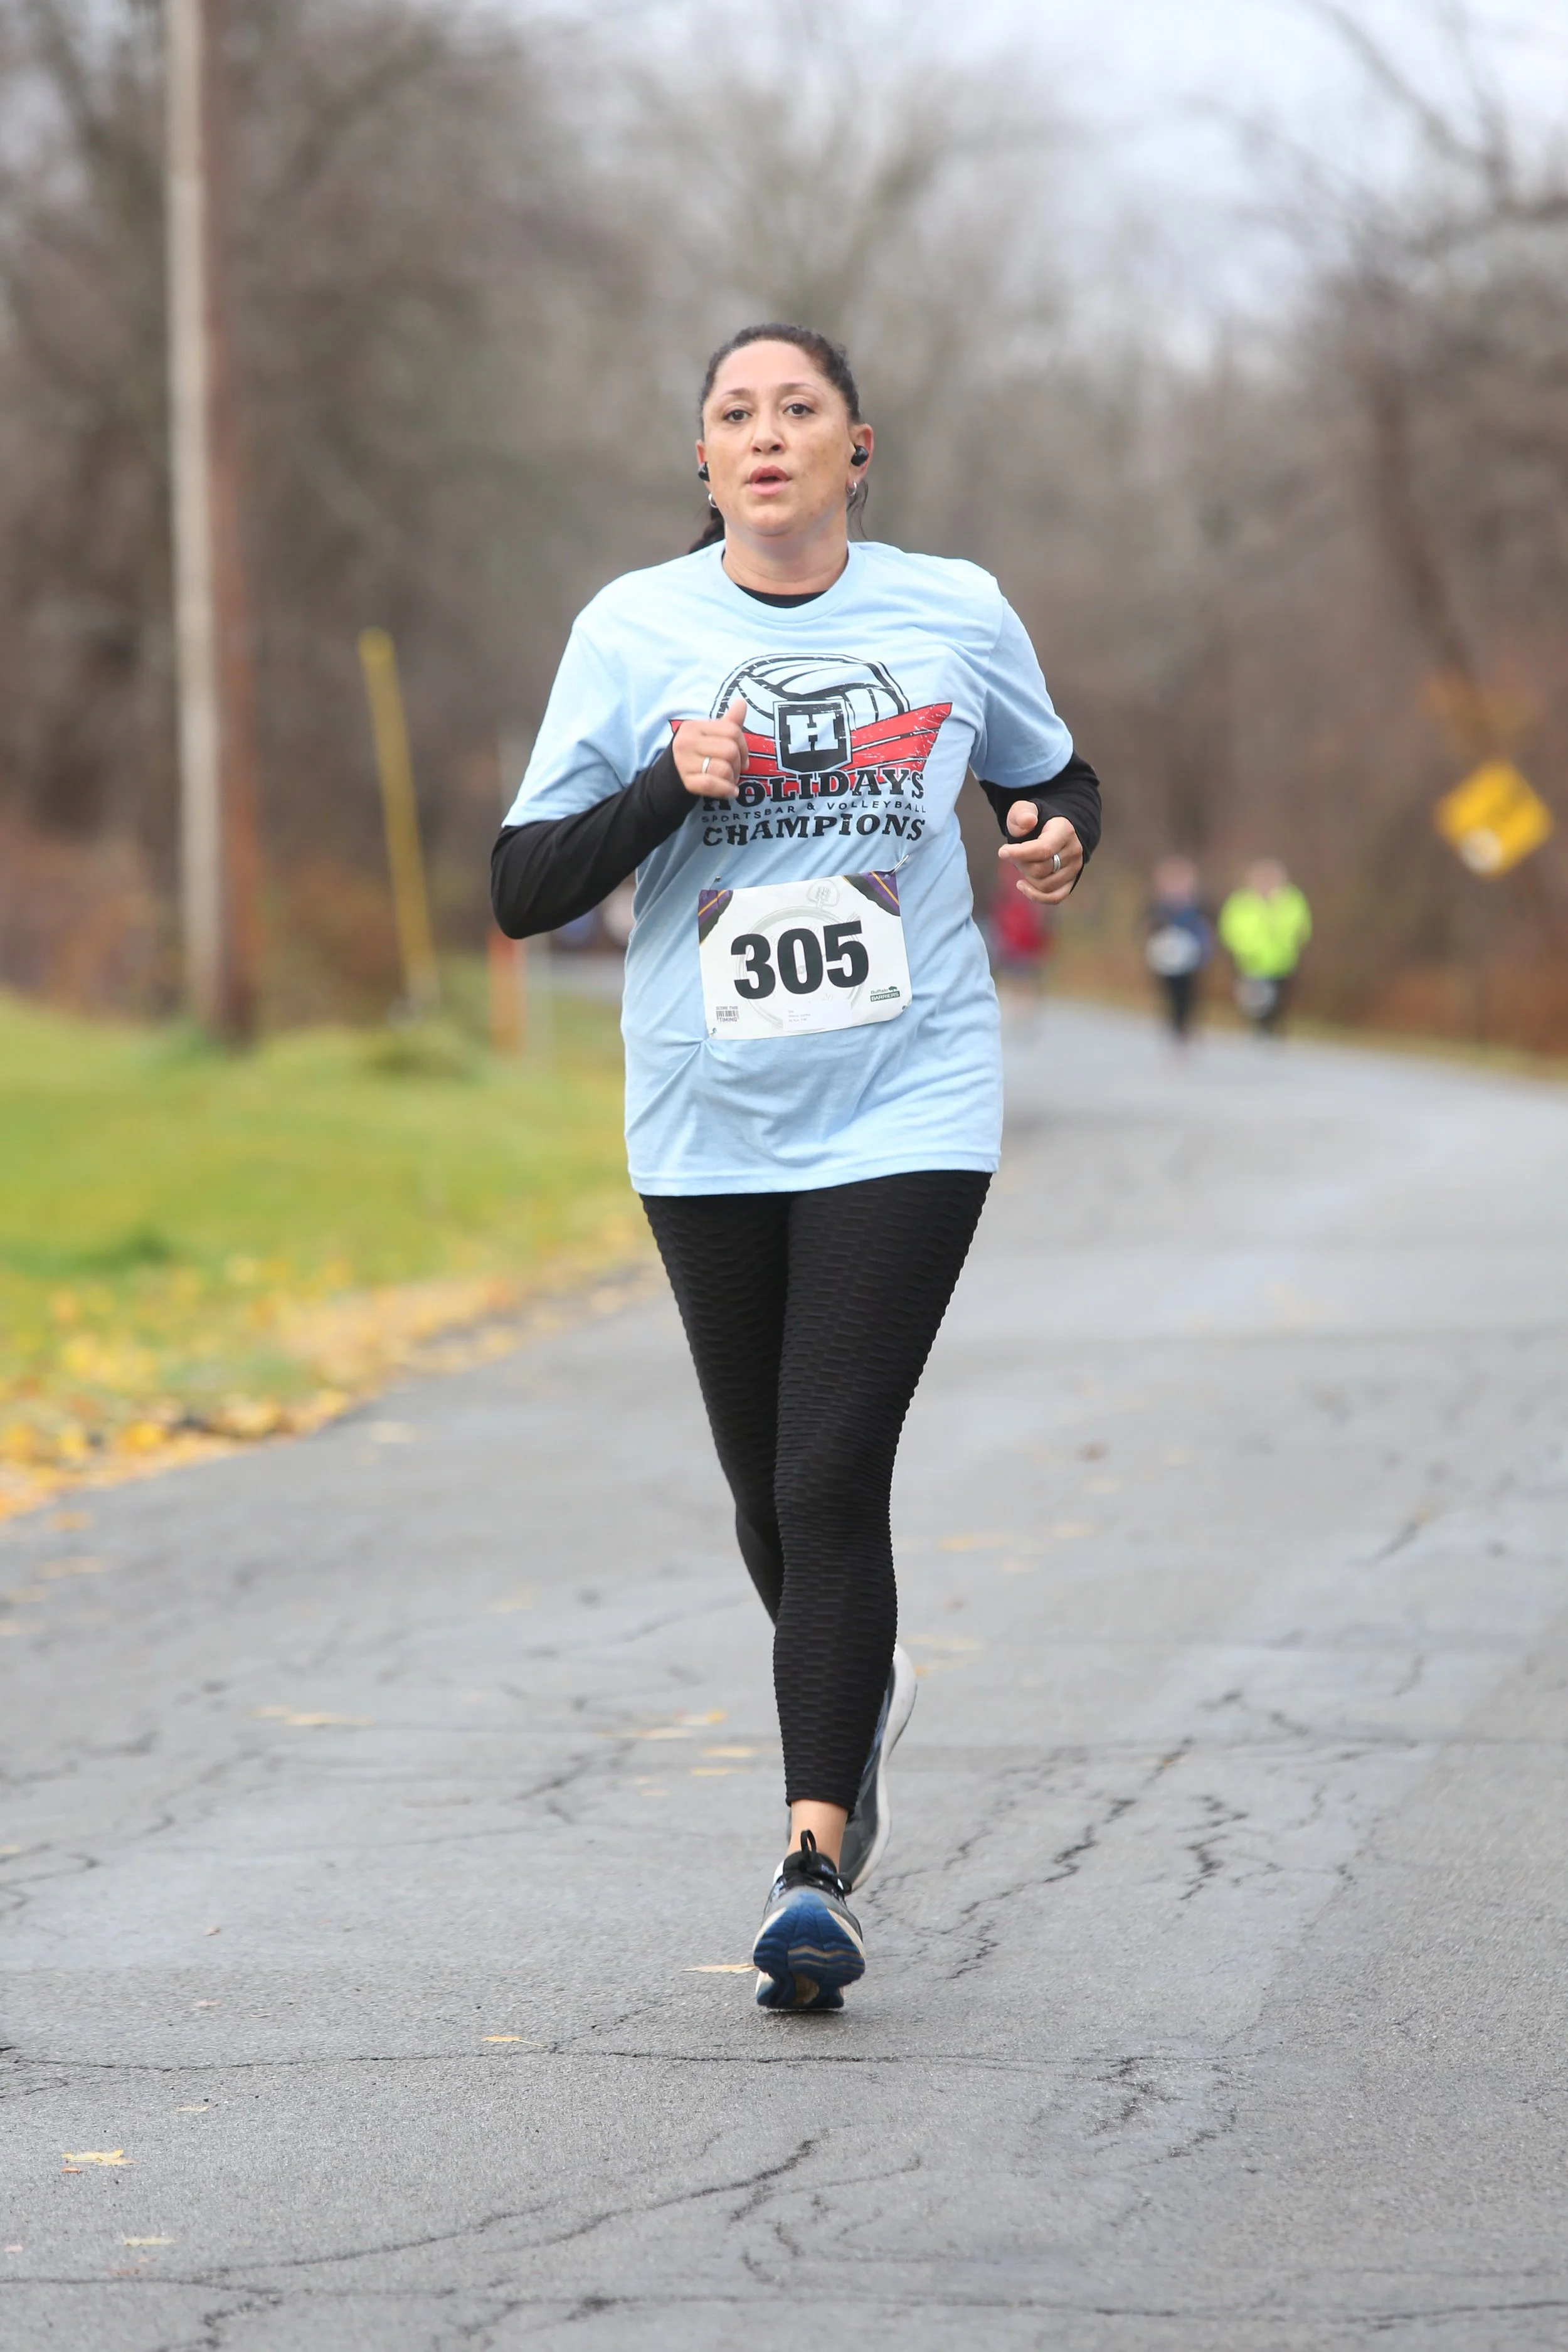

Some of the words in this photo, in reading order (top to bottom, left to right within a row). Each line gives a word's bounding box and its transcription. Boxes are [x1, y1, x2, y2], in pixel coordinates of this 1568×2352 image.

[786, 712, 839, 754] H
[701, 805, 795, 823] SPORTSBAR
[807, 802, 815, 811] &
[827, 800, 926, 813] VOLLEYBALL
[702, 813, 926, 846] CHAMPIONS
[730, 920, 869, 1000] 305
[871, 992, 900, 1001] BARRIERS
